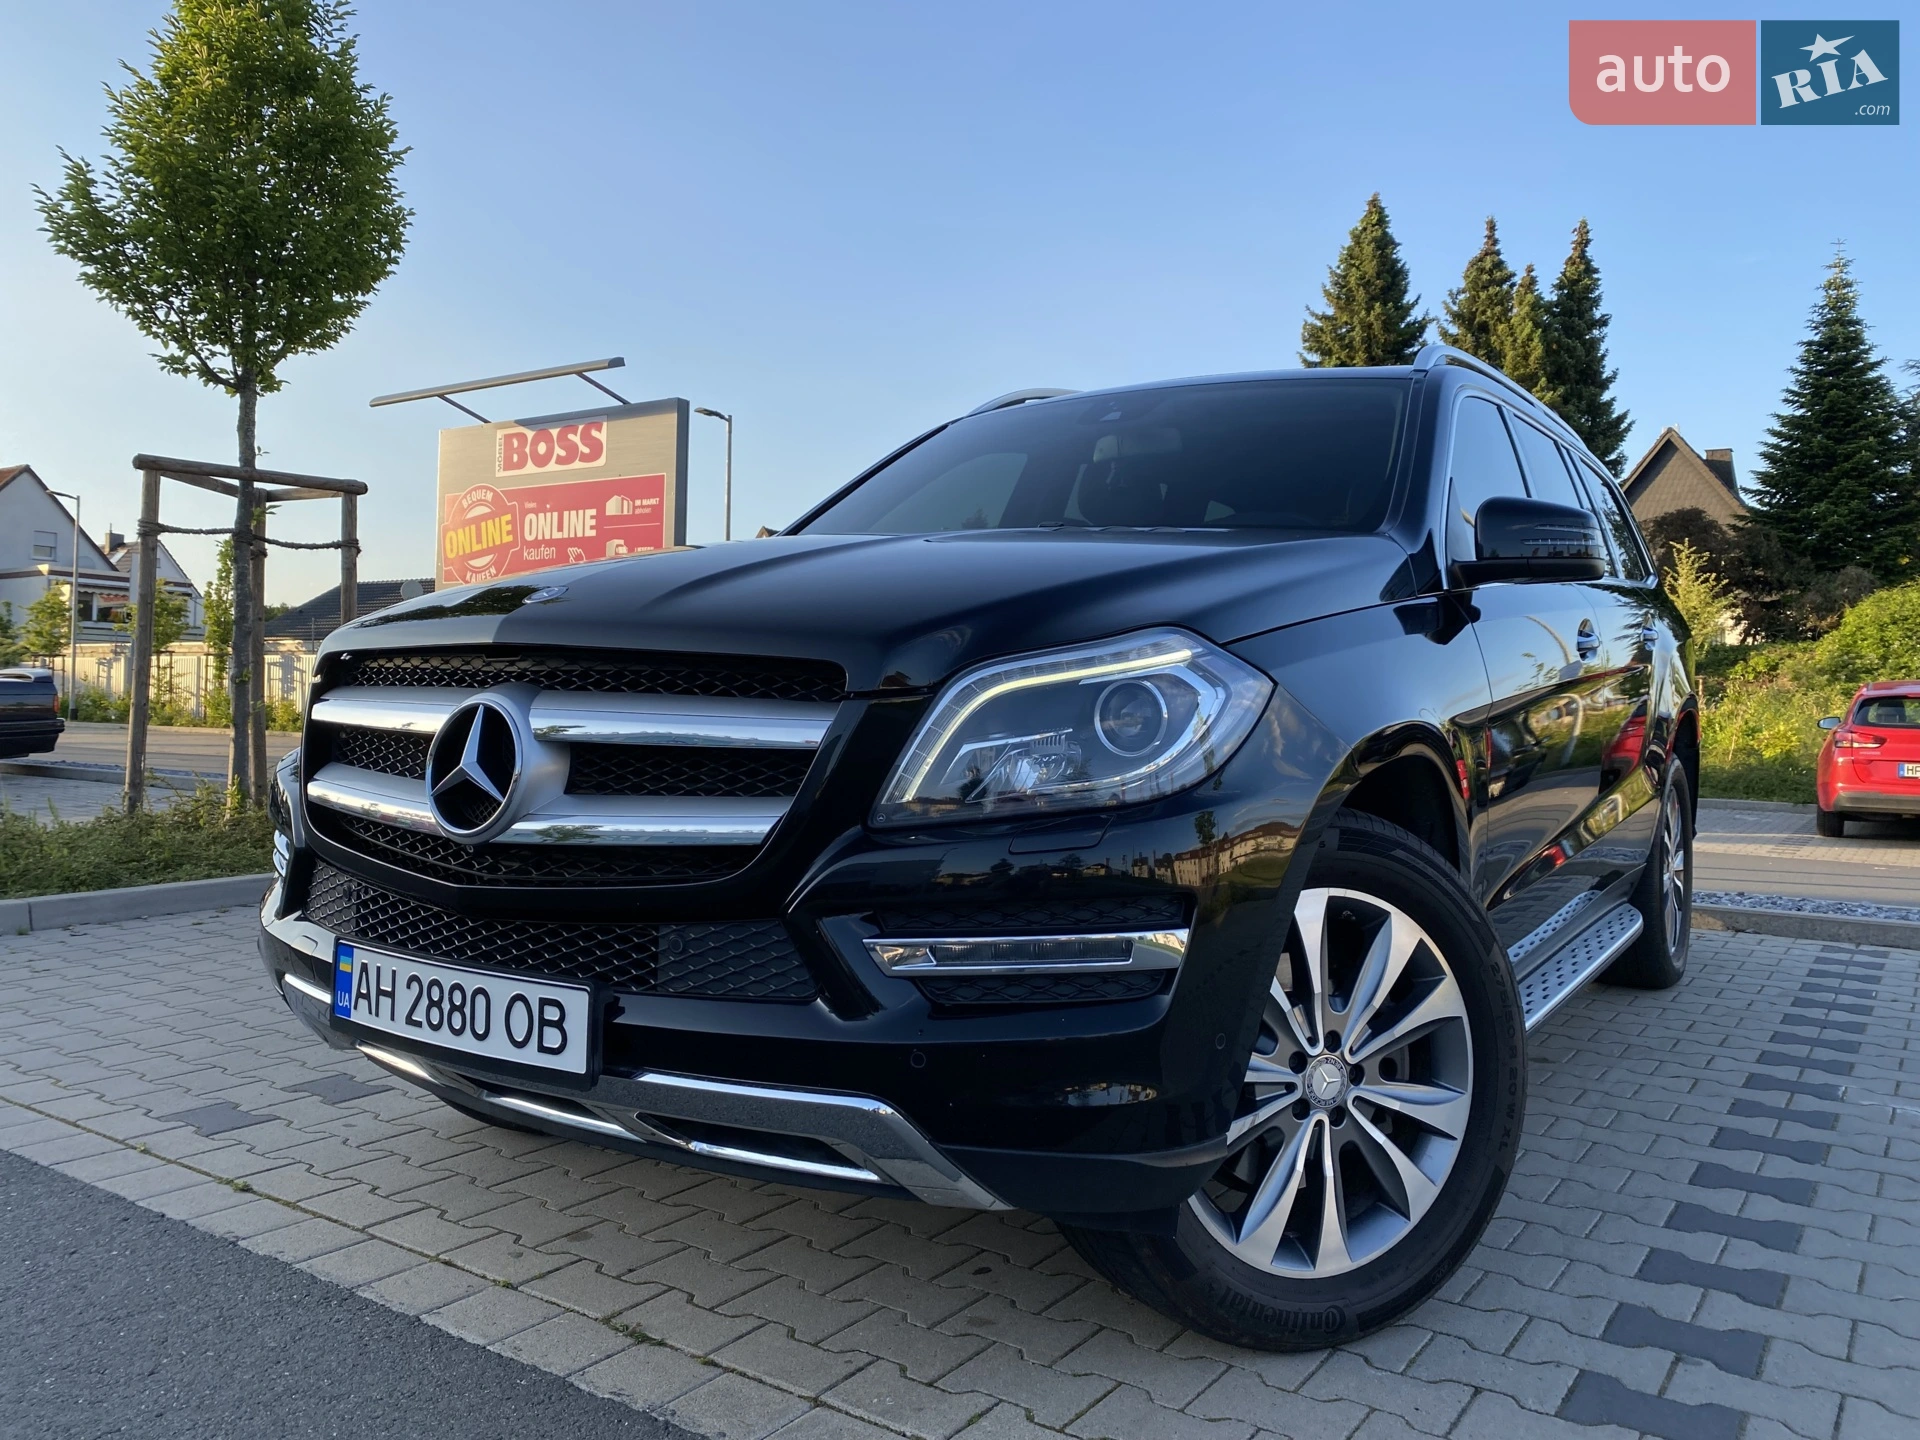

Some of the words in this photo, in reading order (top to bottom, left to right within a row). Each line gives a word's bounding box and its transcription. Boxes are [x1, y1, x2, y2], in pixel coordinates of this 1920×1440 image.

[503, 421, 604, 472] BOSS
[462, 489, 493, 509] BEQUEM
[642, 497, 660, 505] MARKT
[445, 513, 513, 559] ONLINE
[524, 509, 597, 541] ONLINE
[523, 544, 556, 561] kaufen
[337, 990, 351, 1009] UA
[353, 960, 397, 1022] AH
[405, 972, 491, 1042] 2880
[504, 991, 568, 1056] OB
[1217, 1285, 1346, 1334] Continental
